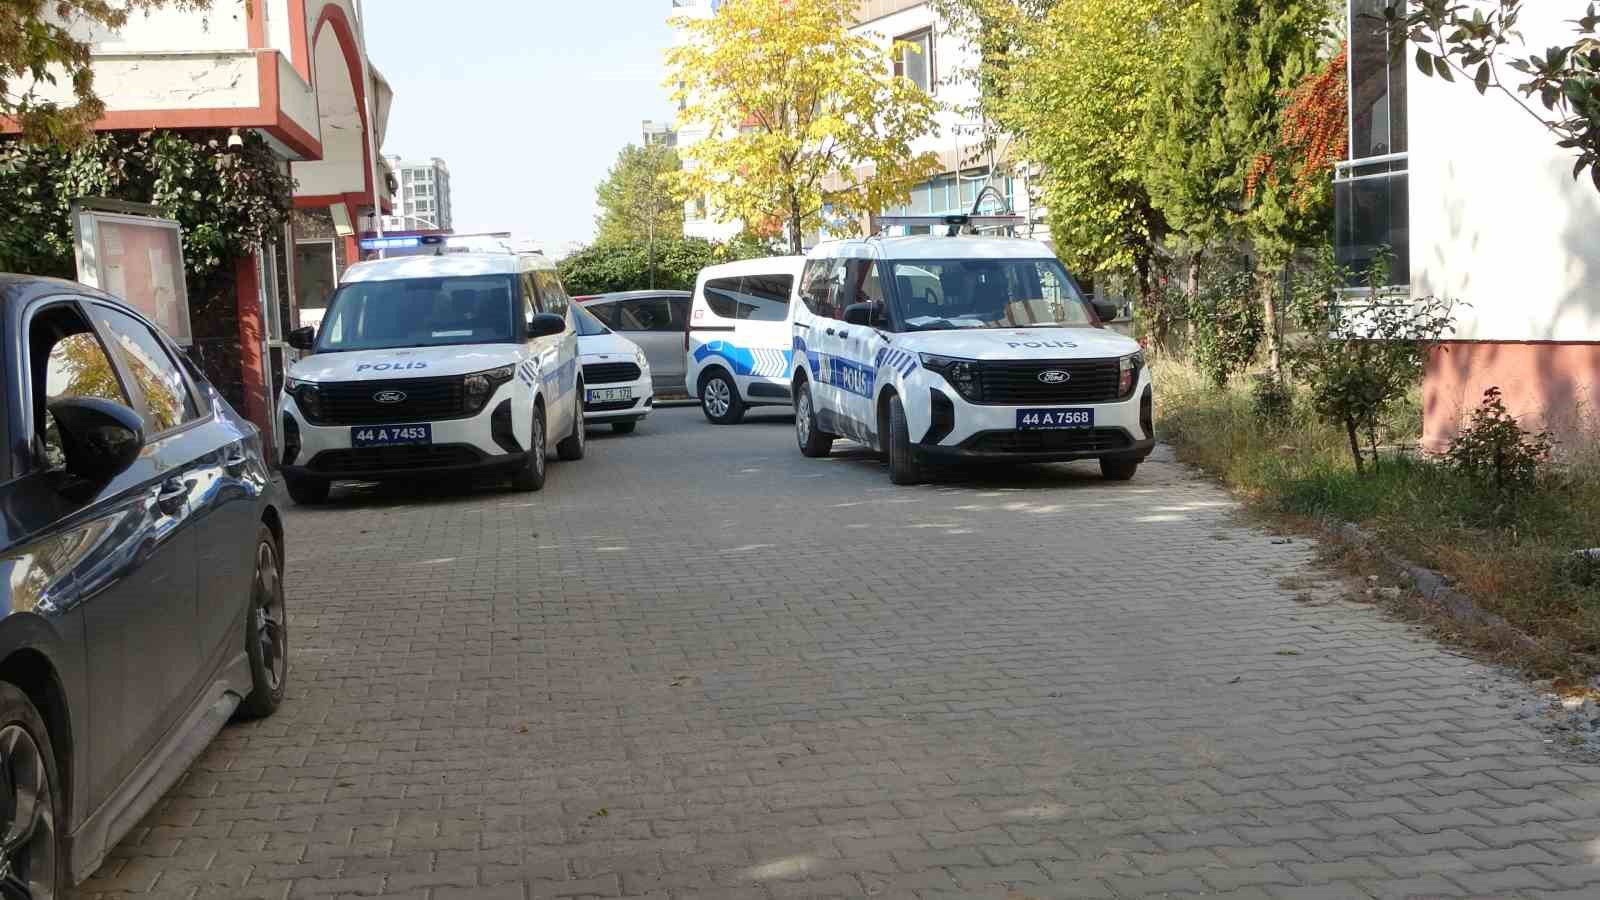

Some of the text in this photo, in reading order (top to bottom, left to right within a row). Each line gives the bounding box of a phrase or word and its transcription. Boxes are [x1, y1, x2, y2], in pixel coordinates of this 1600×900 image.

[1023, 411, 1089, 425] 44 A 7568
[357, 427, 426, 441] 44 A 7453
